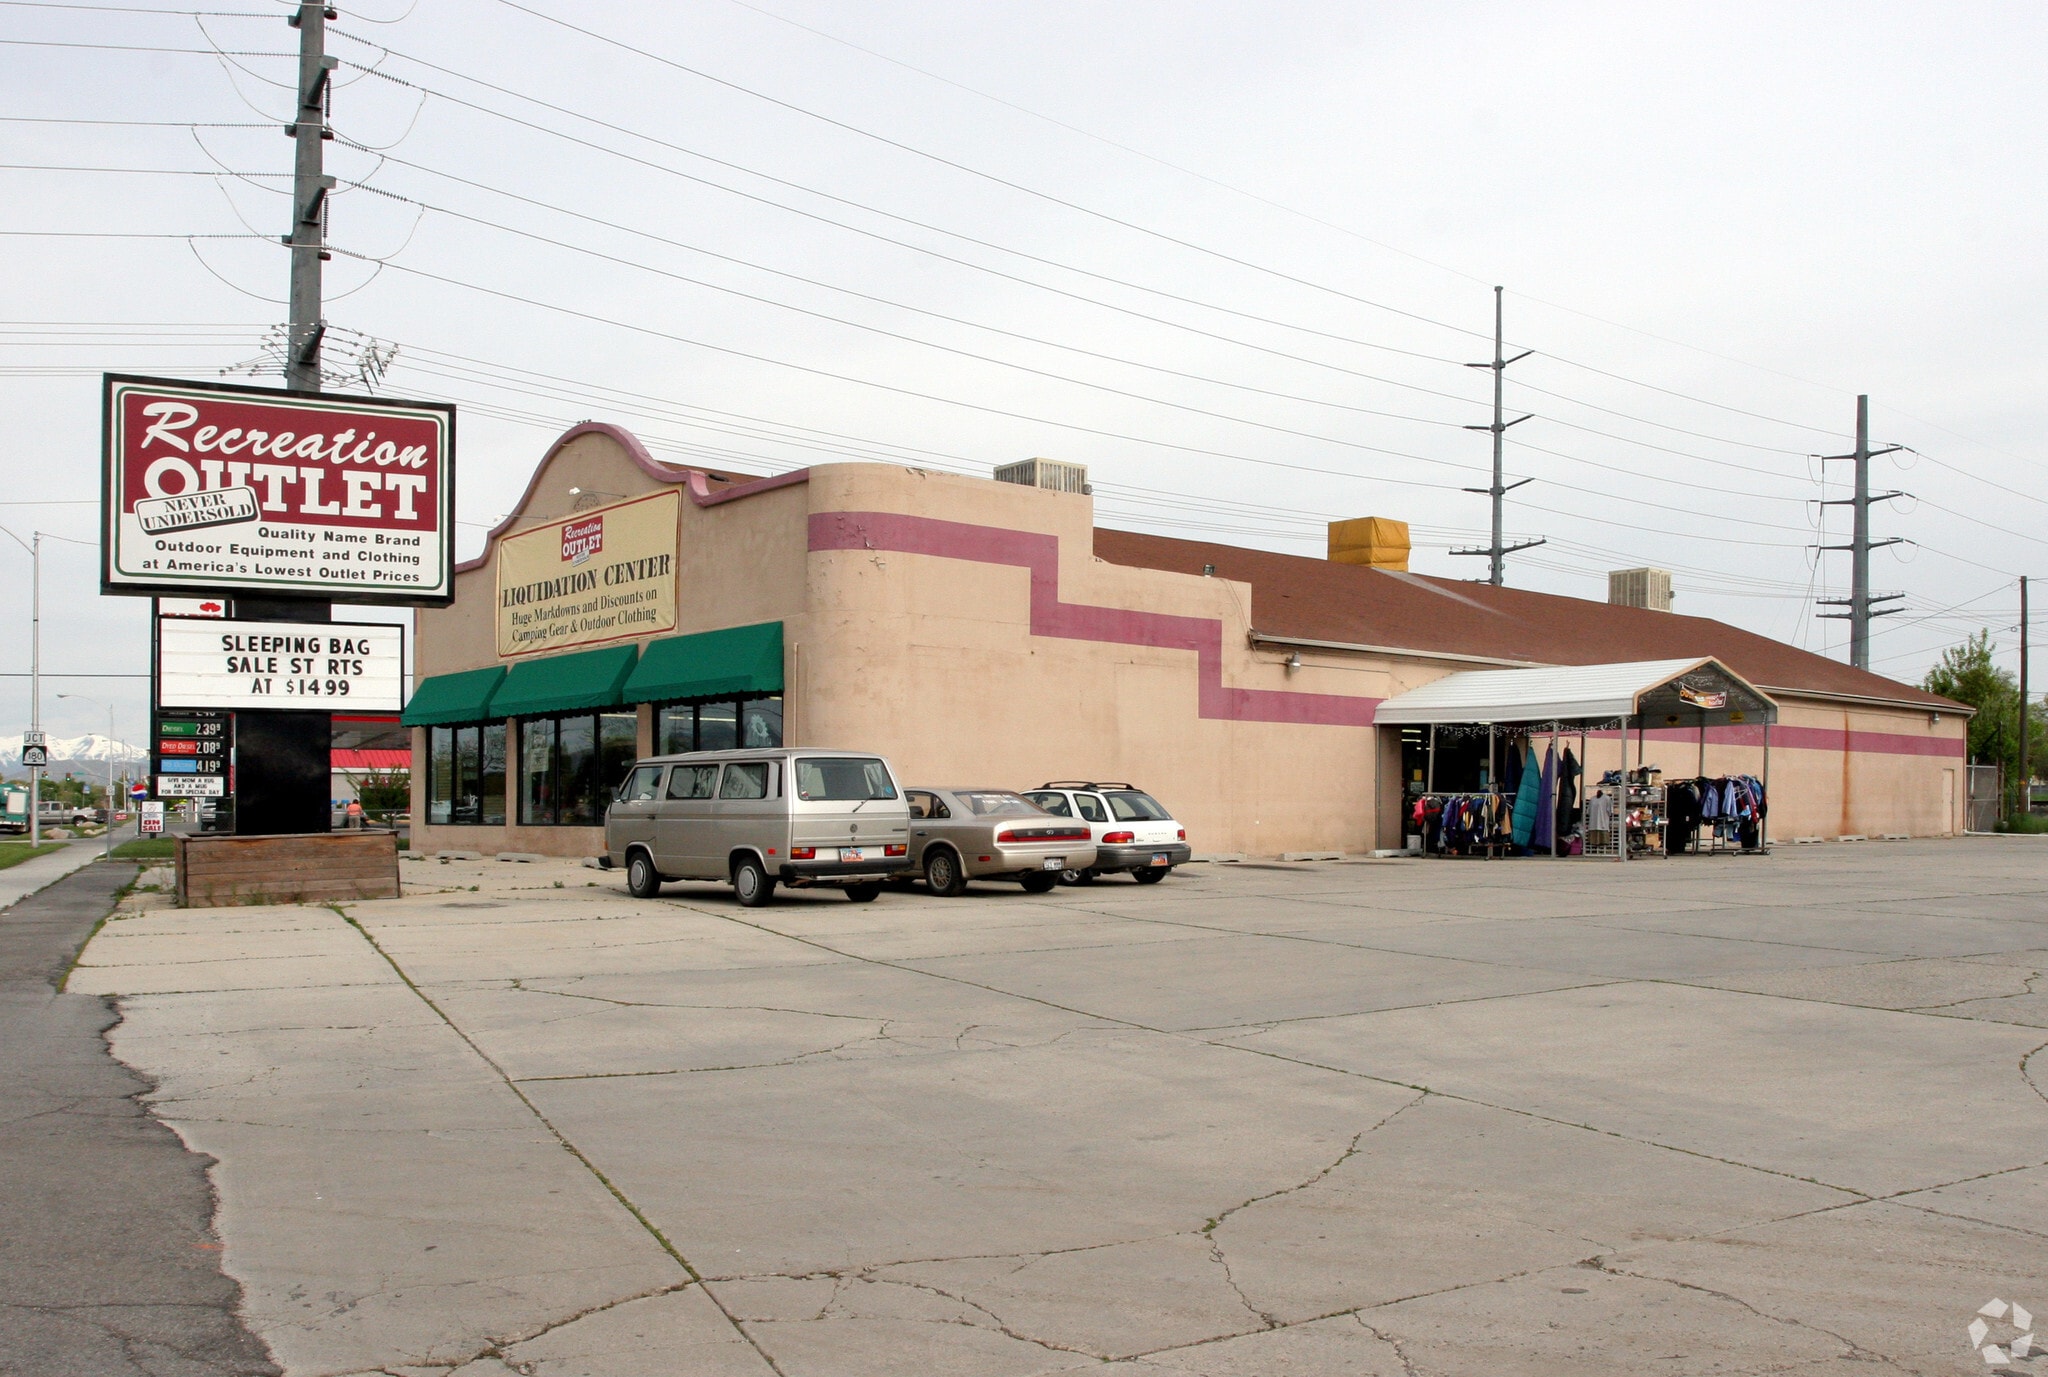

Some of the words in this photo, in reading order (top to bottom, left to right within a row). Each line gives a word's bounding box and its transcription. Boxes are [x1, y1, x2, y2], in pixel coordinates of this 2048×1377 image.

[140, 401, 429, 469] Recreation
[144, 456, 427, 520] OUTLET
[164, 493, 227, 513] NEVER
[143, 503, 252, 529] UNDERSOLD
[258, 526, 316, 543] Quality
[323, 530, 368, 544] Name
[375, 533, 421, 547] Brand
[565, 521, 602, 541] Recreation
[155, 540, 222, 554] Outdoor
[229, 543, 315, 559] Equipment
[322, 550, 350, 561] and
[357, 550, 421, 566] Clothing
[562, 533, 602, 557] OUTLET
[142, 559, 160, 570] at
[166, 558, 248, 574] America's
[255, 563, 312, 578] Lowest
[318, 567, 366, 580] Outlet
[373, 570, 420, 582] Prices
[502, 568, 598, 608] LIQUIDATION
[604, 553, 670, 586] CENTER
[511, 611, 533, 628] Huge
[534, 604, 581, 623] Markdowns
[582, 597, 598, 613] and
[600, 590, 644, 610] Discounts
[645, 588, 657, 601] on
[511, 626, 547, 644] Camping
[549, 622, 569, 637] Gear
[570, 619, 578, 634] &
[580, 615, 616, 632] Outdoor
[618, 606, 656, 624] Clothing
[221, 634, 320, 654] SLEEPING
[329, 638, 370, 655] BAG
[227, 656, 278, 674] SALE
[290, 657, 314, 675] ST
[328, 658, 363, 676] RTS
[251, 677, 272, 695] AT
[26, 734, 43, 742] JCT
[28, 752, 42, 760] 180
